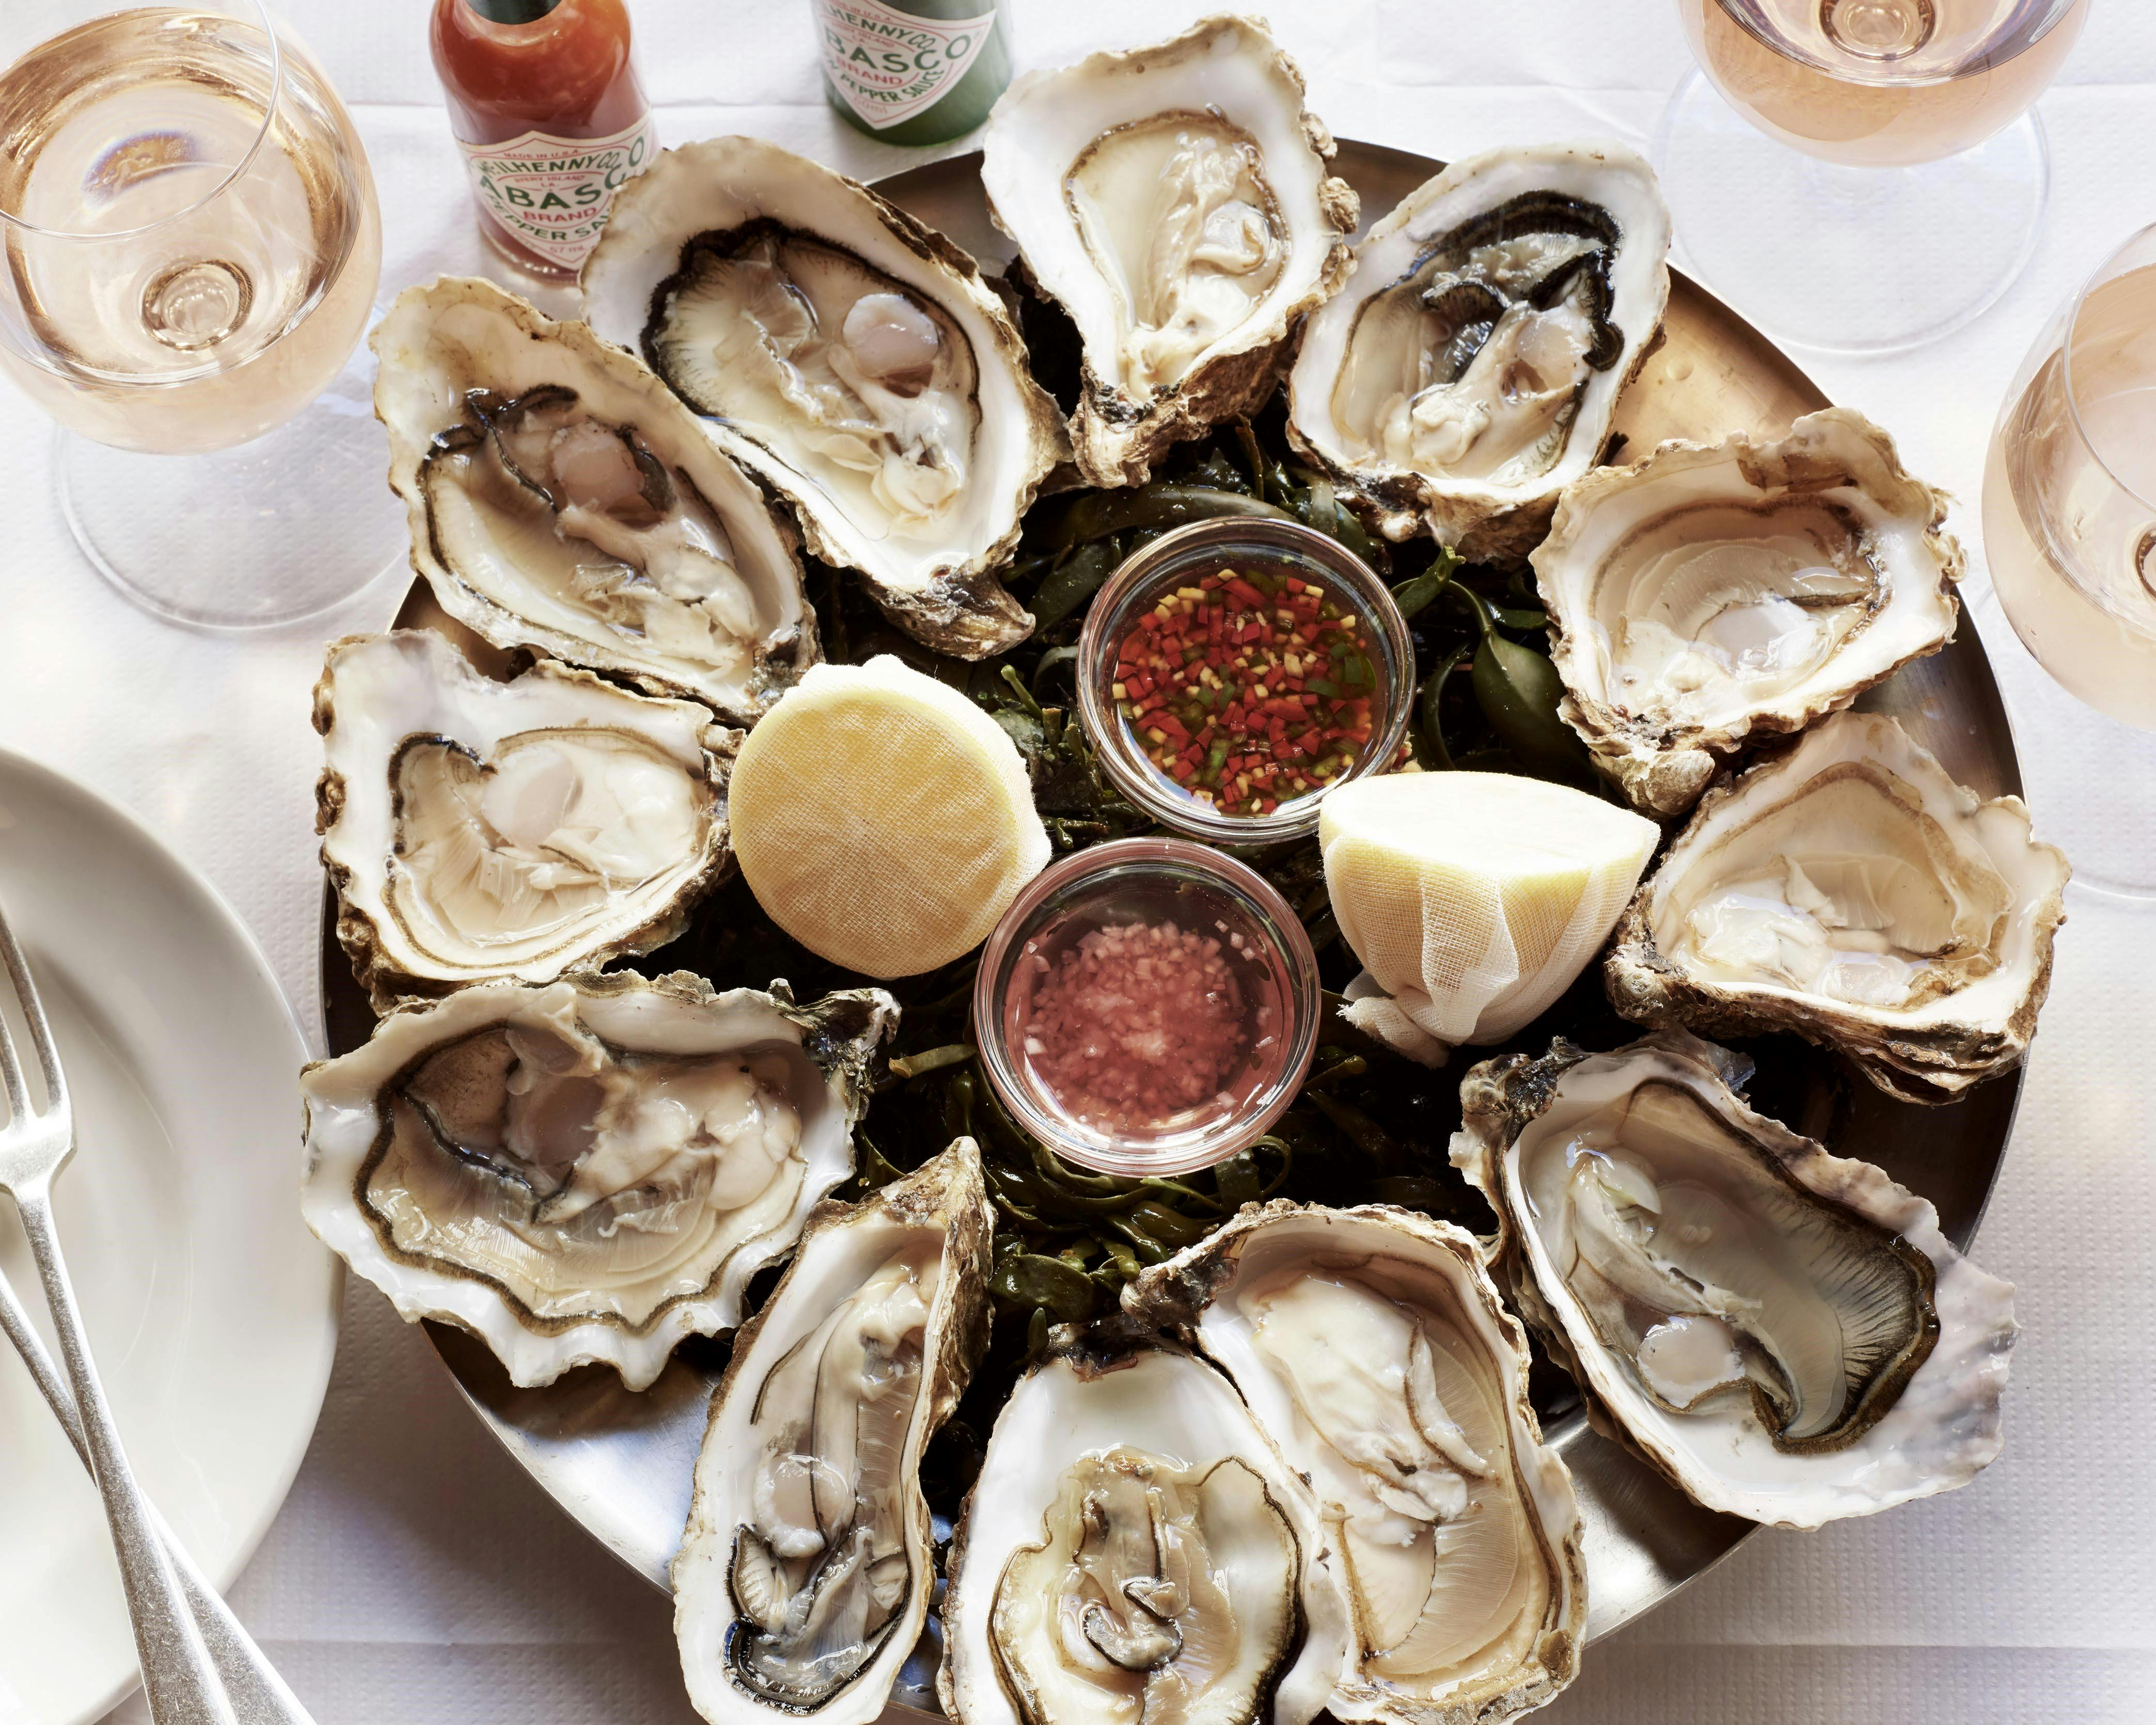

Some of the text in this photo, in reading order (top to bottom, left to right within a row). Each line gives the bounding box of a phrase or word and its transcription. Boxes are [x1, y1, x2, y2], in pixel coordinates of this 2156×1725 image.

[836, 55, 902, 84] BRAND
[841, 70, 945, 102] PEPPER SAUCE
[466, 136, 644, 210] ABASCO
[523, 207, 597, 222] BRAND
